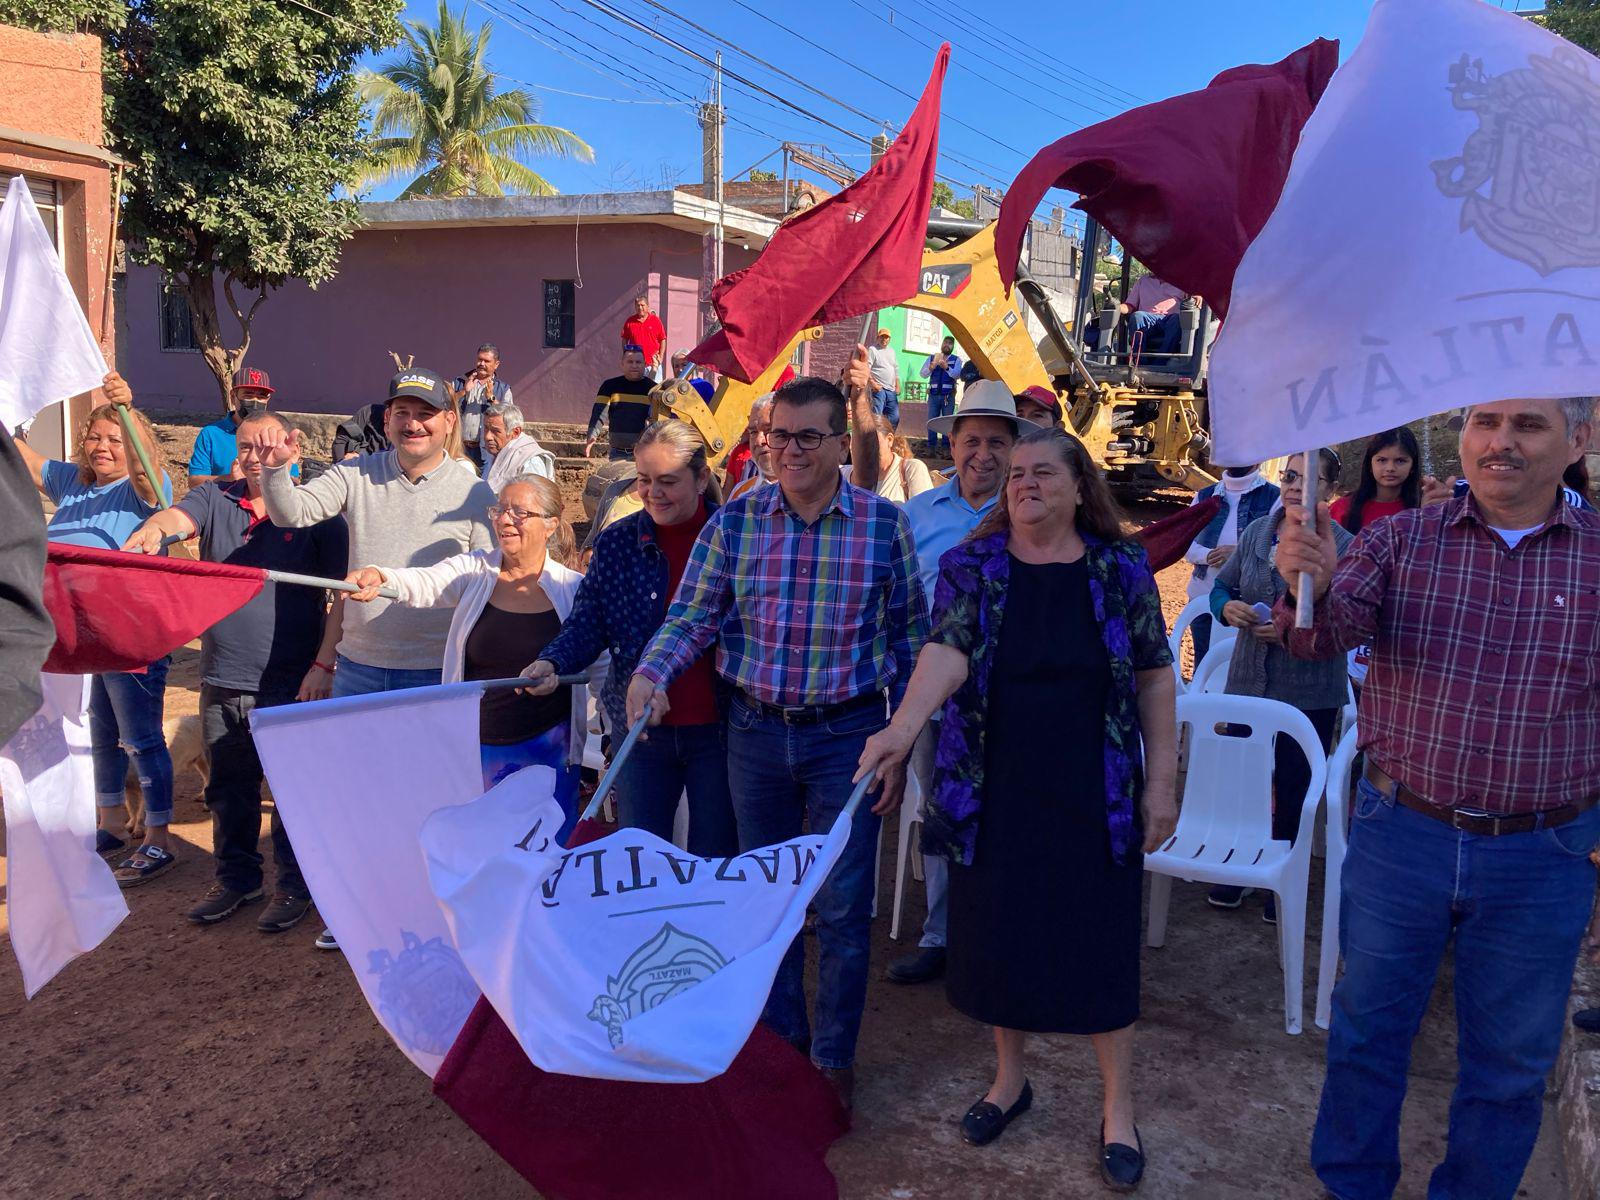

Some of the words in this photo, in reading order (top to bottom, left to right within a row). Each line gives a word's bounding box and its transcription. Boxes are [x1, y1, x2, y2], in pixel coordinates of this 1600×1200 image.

[922, 272, 950, 294] CAT
[985, 327, 1003, 348] MATCO
[400, 374, 435, 387] CASE
[649, 967, 691, 981] MAZATL
